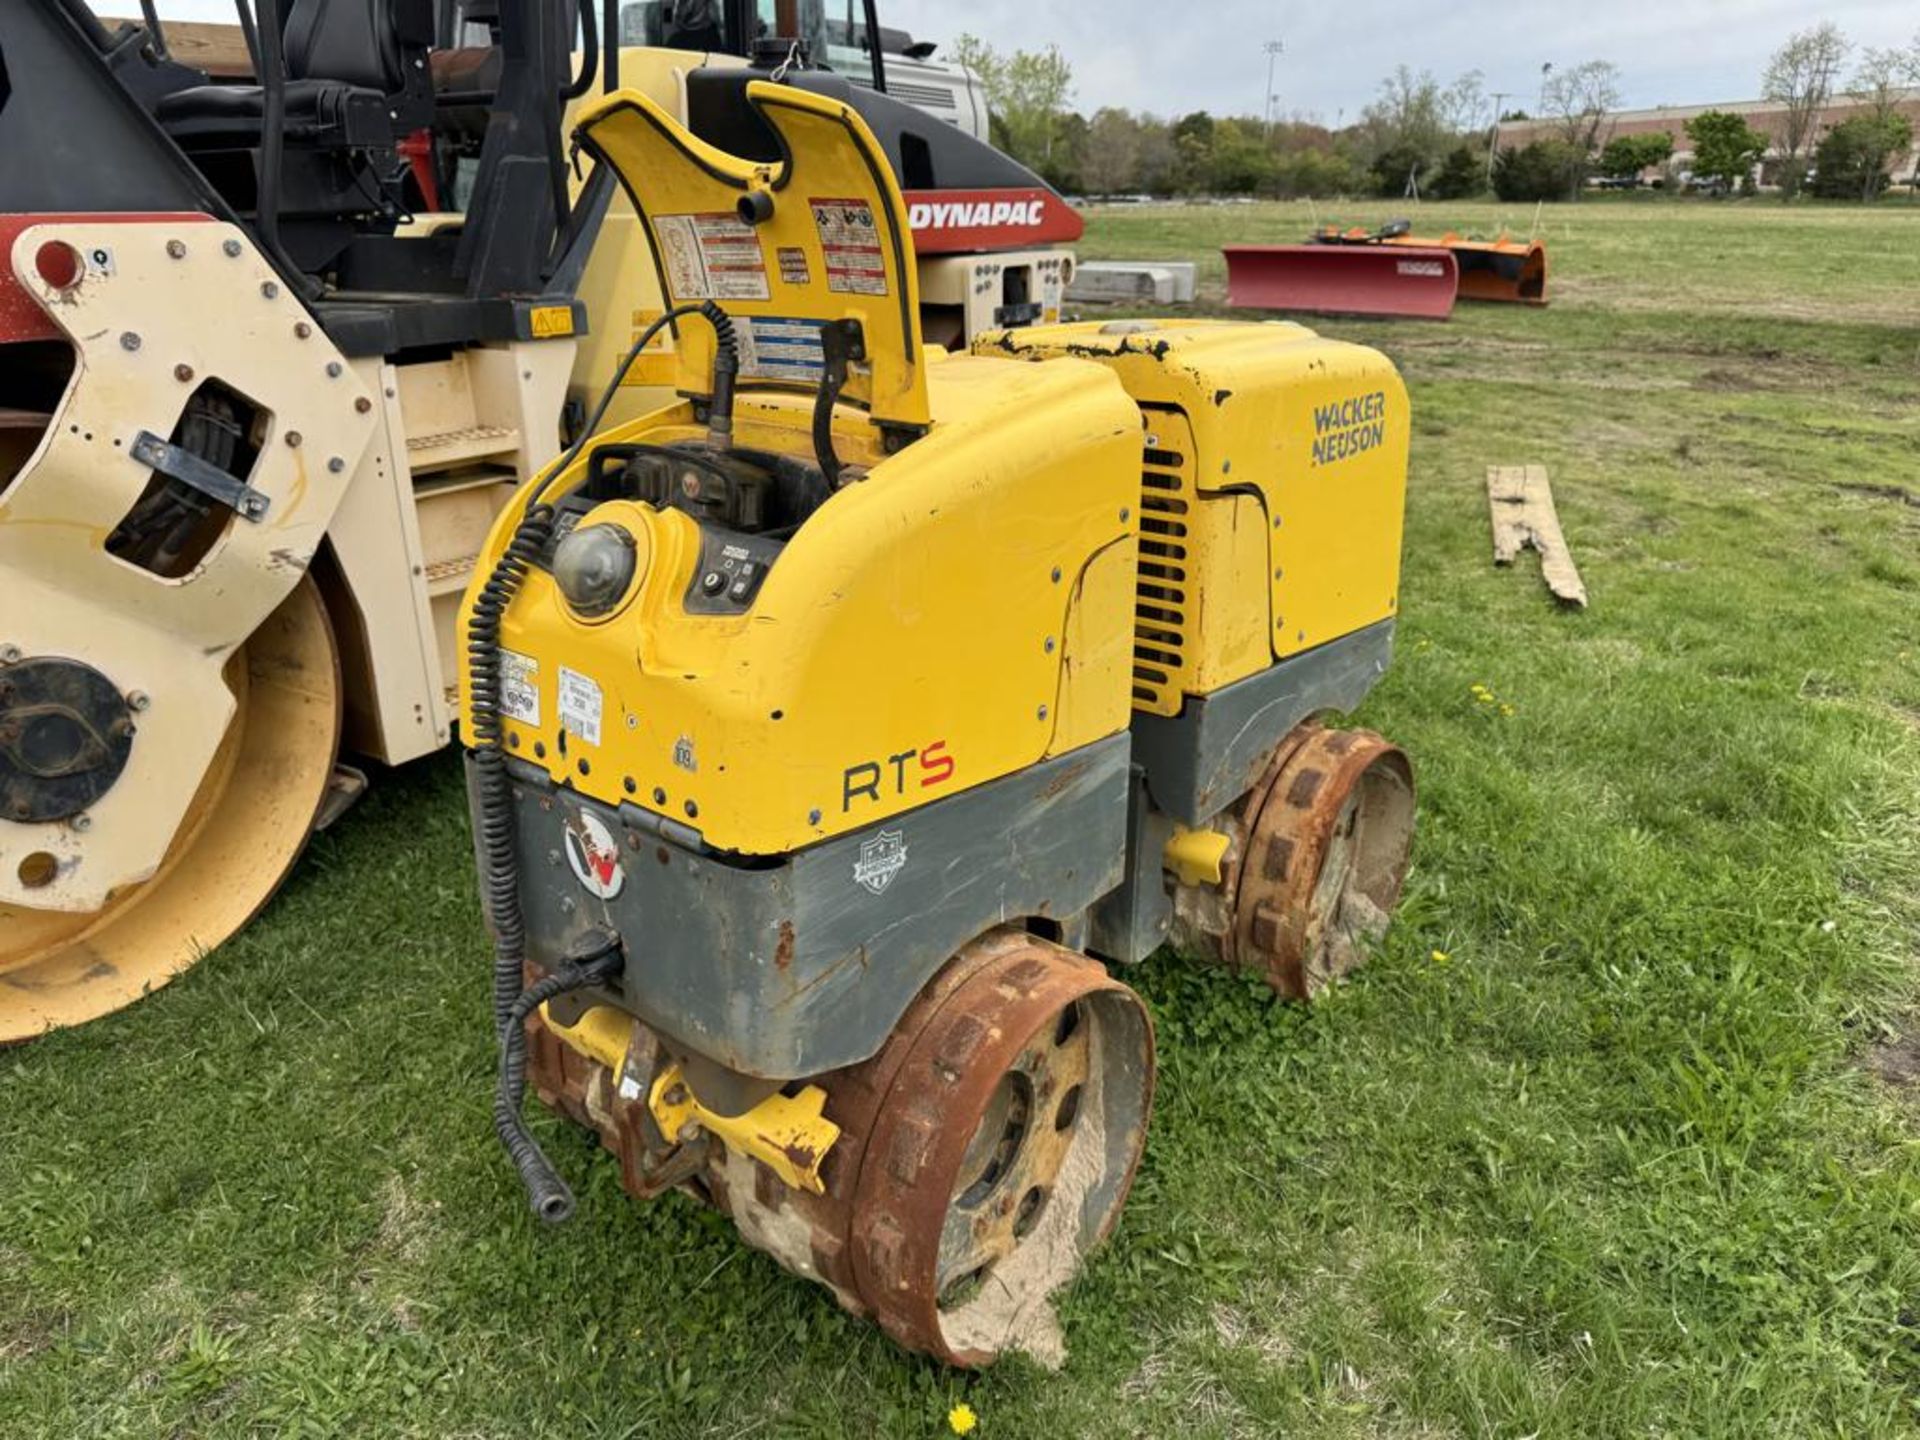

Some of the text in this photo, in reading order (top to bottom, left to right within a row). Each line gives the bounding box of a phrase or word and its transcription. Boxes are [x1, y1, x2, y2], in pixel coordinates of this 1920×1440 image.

[909, 201, 1045, 229] DYNAPAC
[1314, 391, 1384, 435] WACKER
[1312, 420, 1384, 465] NEUSON
[842, 740, 955, 813] RTS
